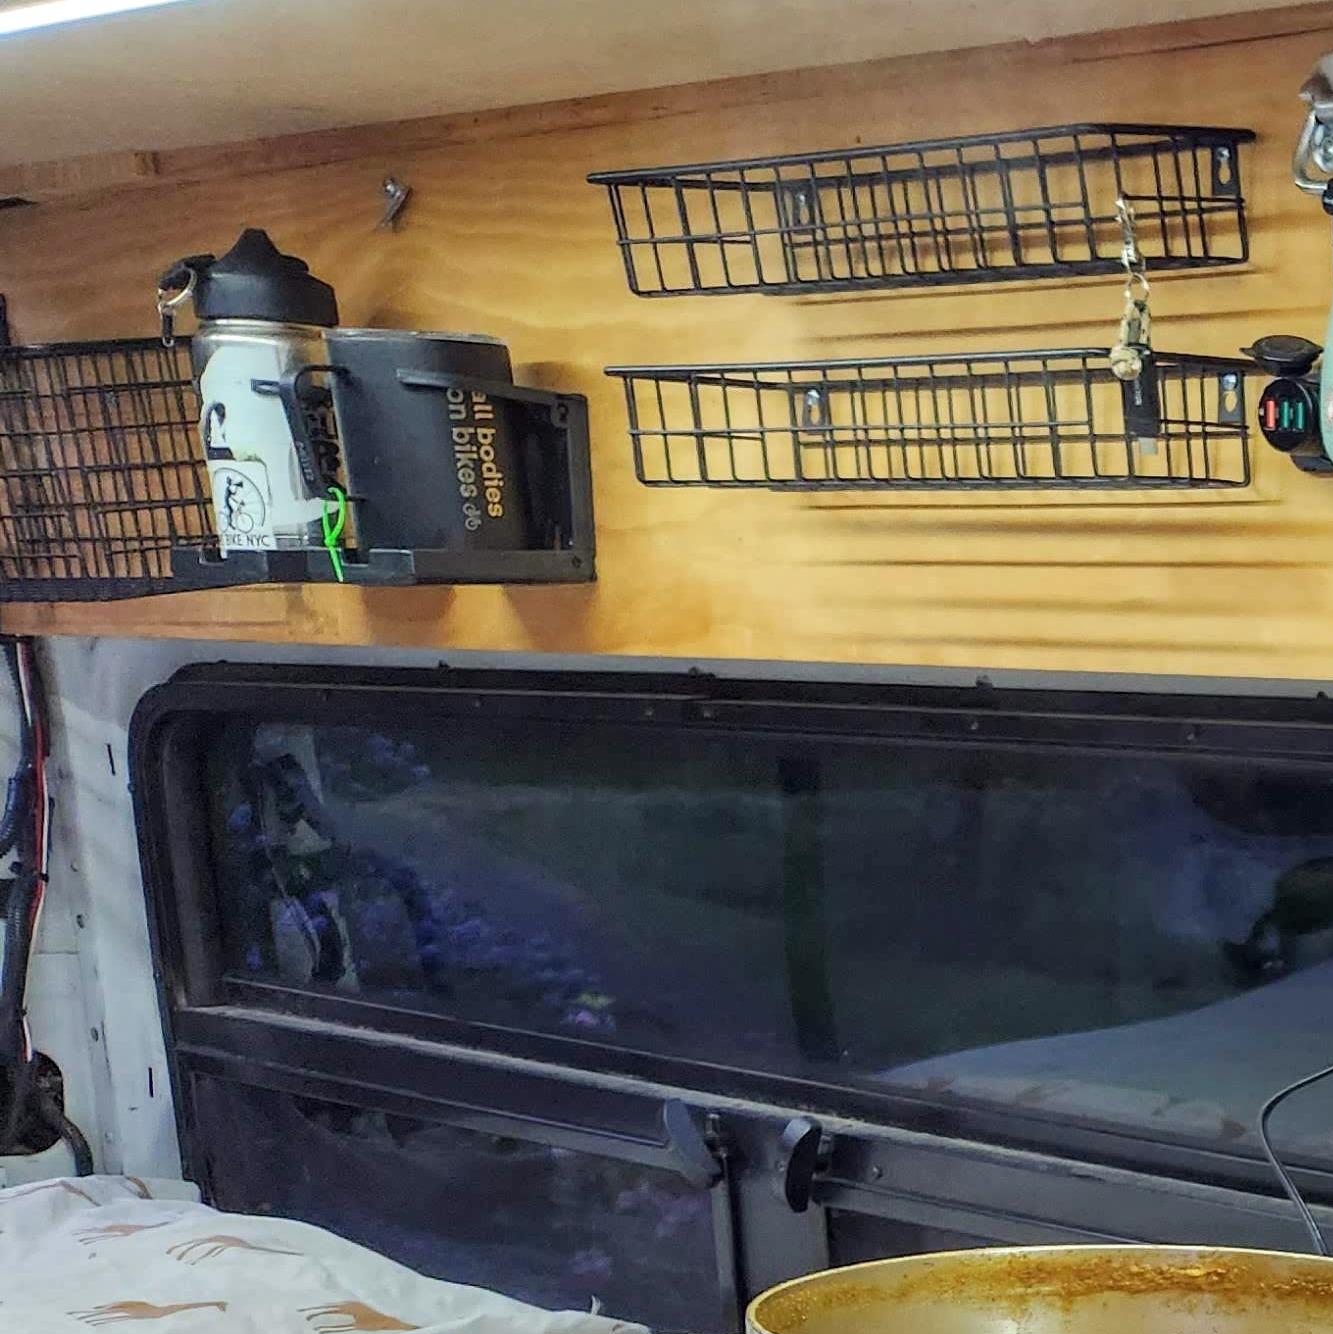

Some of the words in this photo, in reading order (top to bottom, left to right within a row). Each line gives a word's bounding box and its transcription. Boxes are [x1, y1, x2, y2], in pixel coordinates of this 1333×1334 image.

[447, 388, 466, 420] on
[472, 391, 494, 420] all
[452, 427, 478, 498] bikes
[477, 427, 504, 518] bodies
[246, 534, 271, 547] NYC
